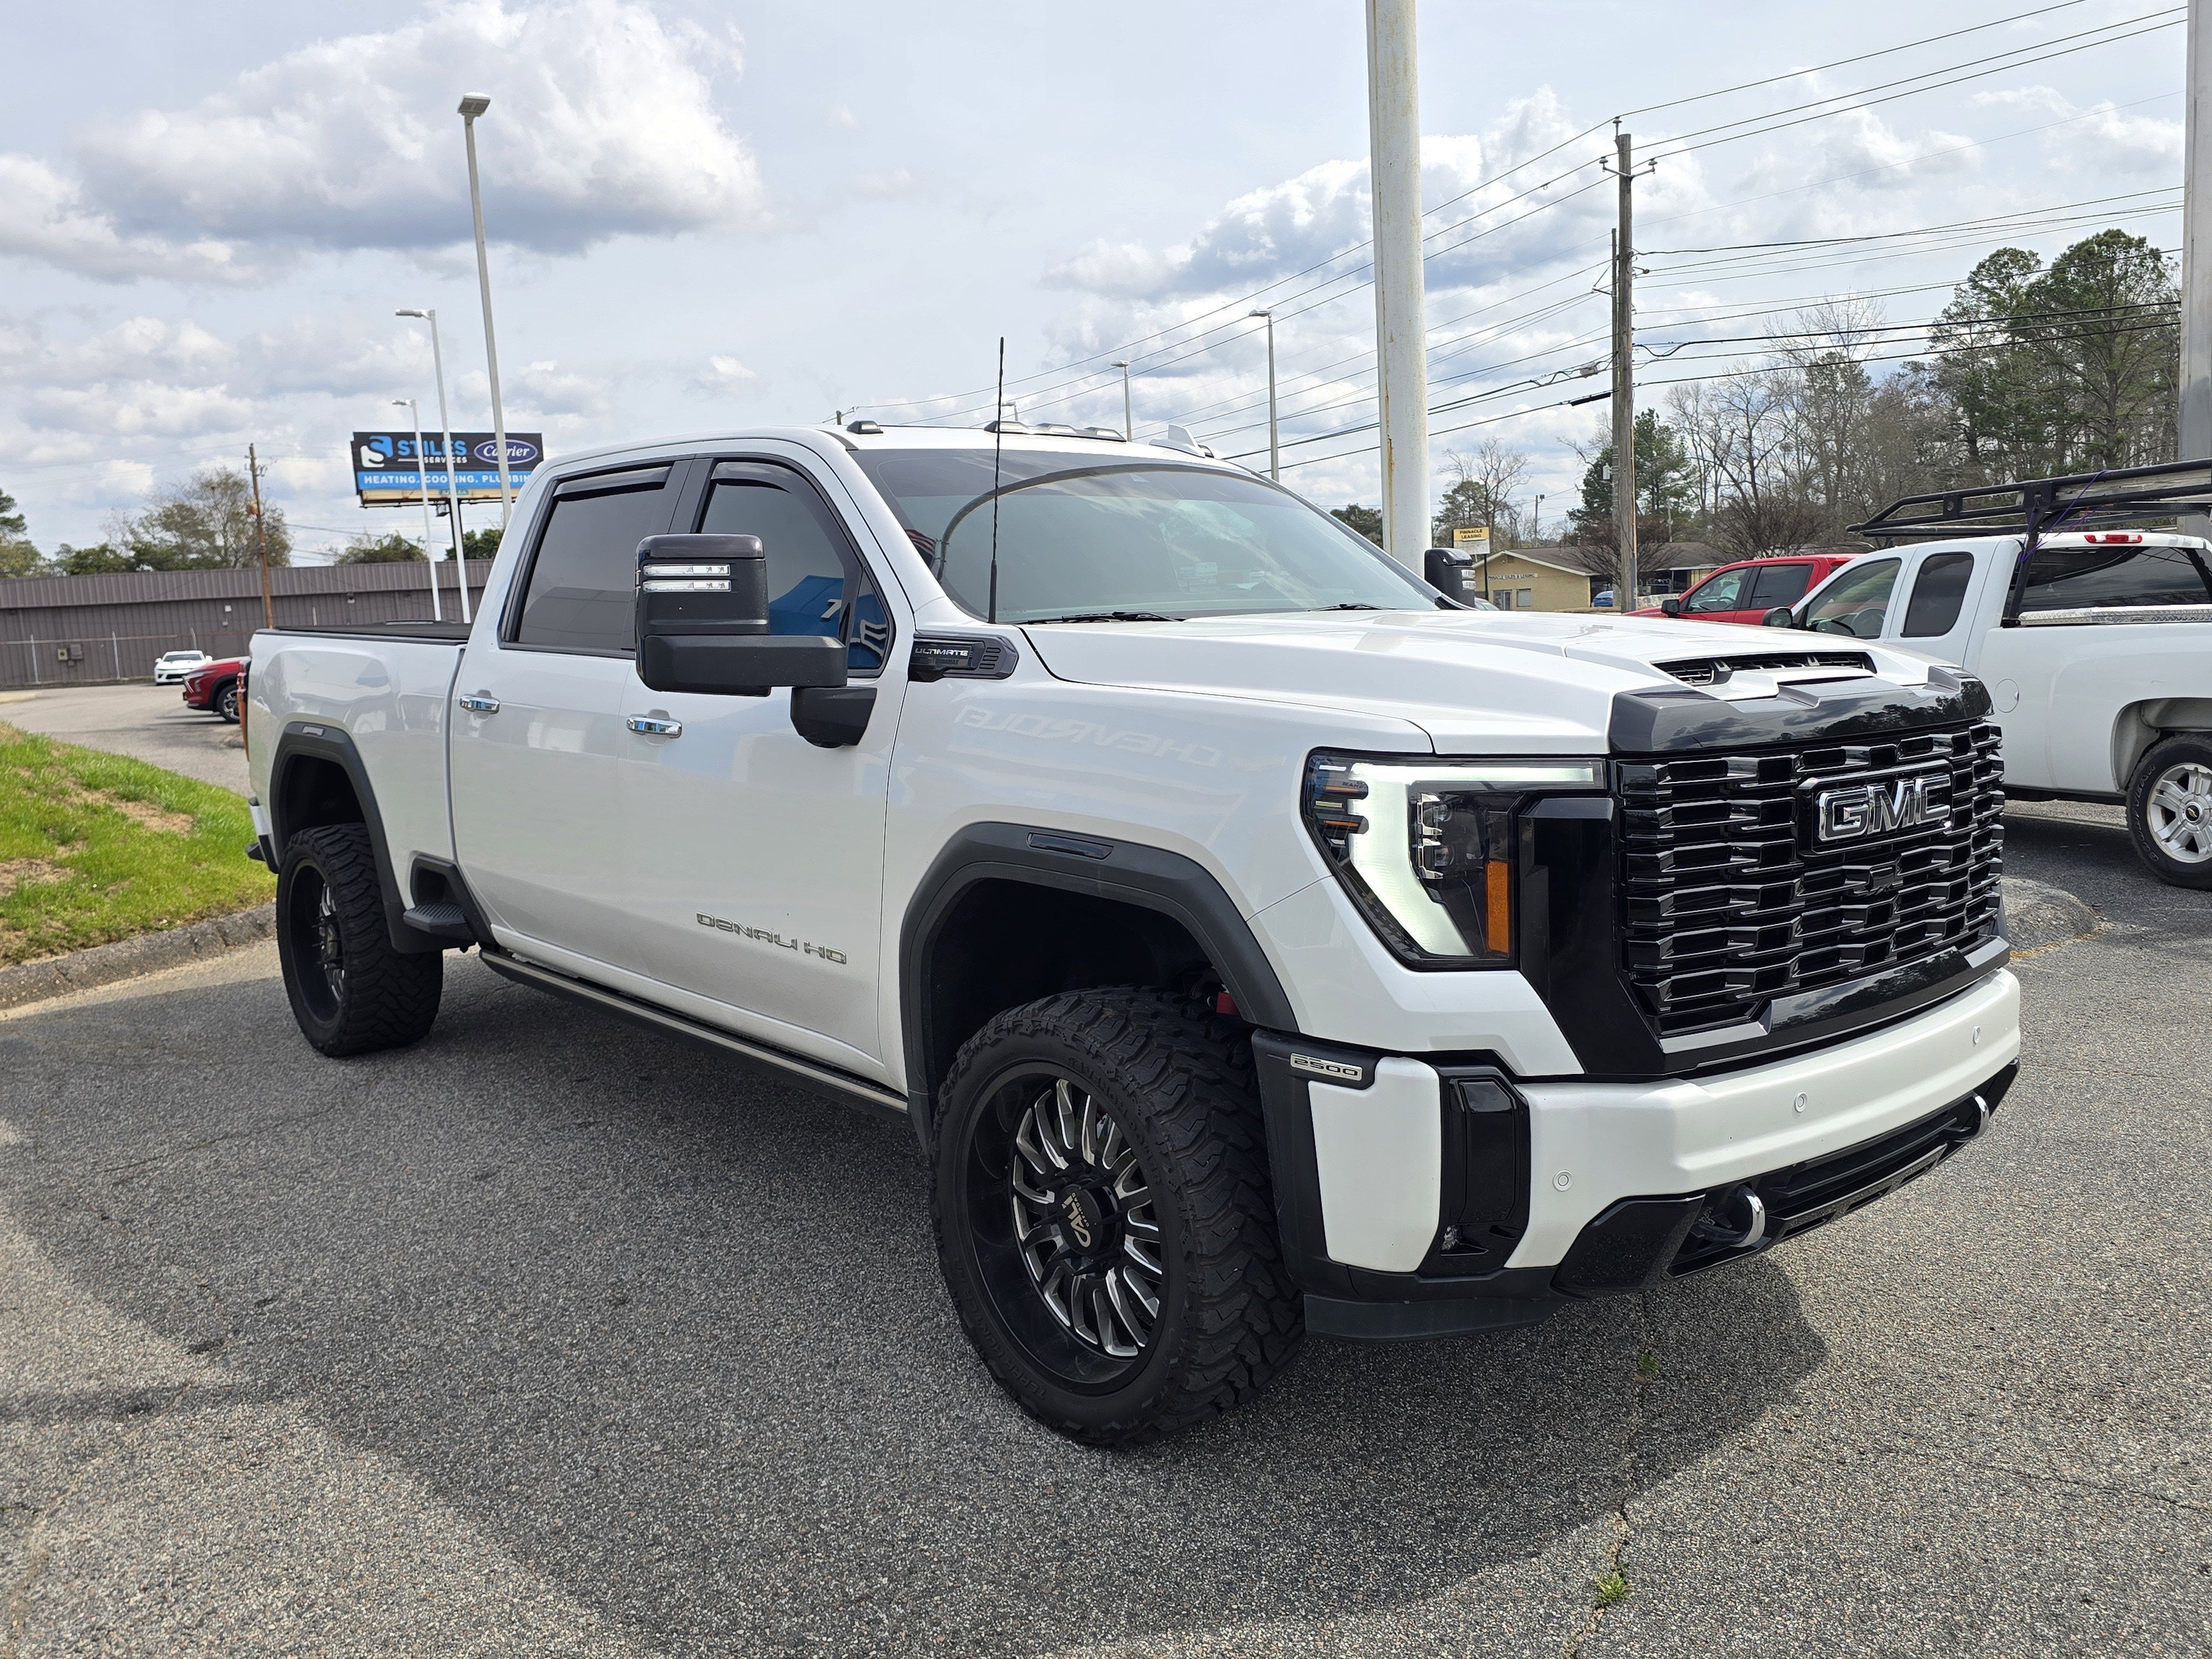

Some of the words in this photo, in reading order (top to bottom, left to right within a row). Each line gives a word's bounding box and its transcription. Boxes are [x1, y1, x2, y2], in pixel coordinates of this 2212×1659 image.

[483, 445, 530, 457] Carier
[364, 476, 420, 484] HEATING.
[424, 475, 478, 483] COOING.
[915, 648, 969, 656] ULTIMATE
[1817, 774, 1951, 842] GMC
[696, 911, 798, 951] DENALI
[804, 940, 847, 964] HD
[1294, 1057, 1358, 1076] 2500
[1062, 1196, 1091, 1248] CALI
